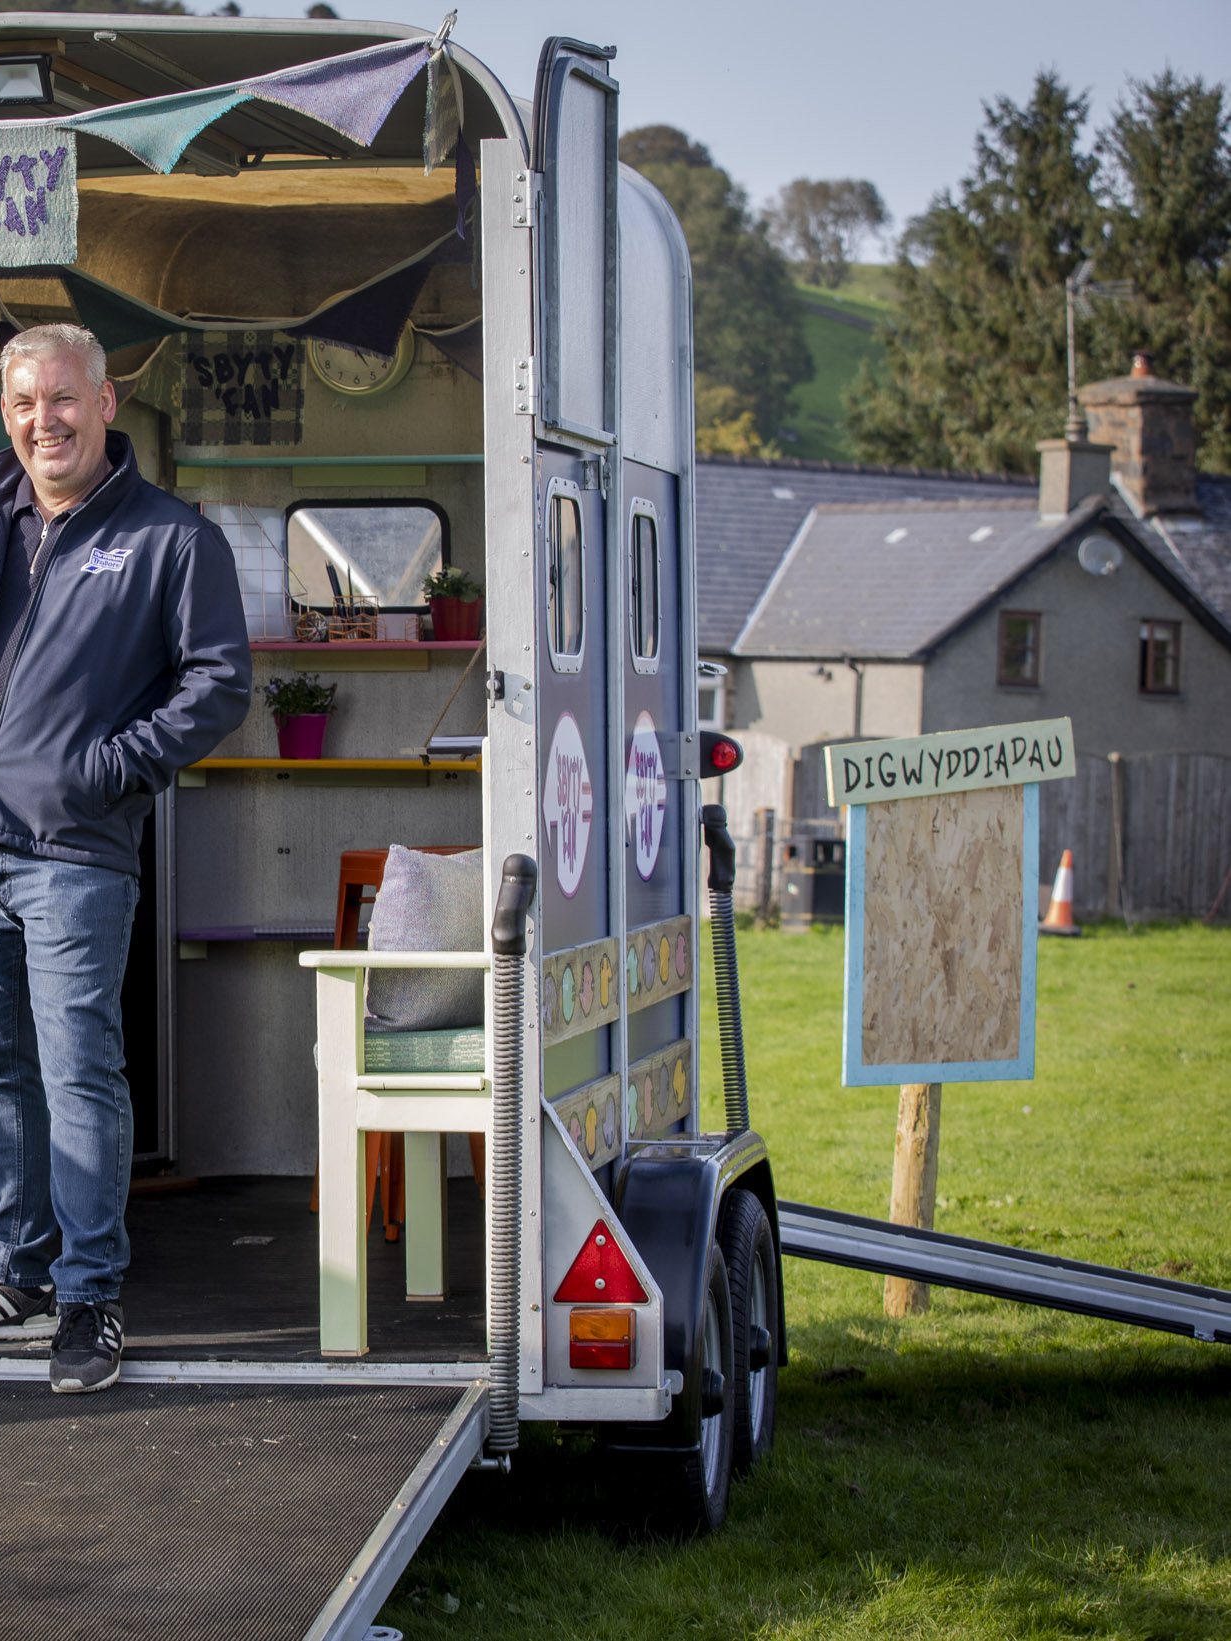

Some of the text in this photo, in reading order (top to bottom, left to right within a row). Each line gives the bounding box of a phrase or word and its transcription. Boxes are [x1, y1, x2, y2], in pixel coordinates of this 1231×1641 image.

[318, 343, 325, 352] 9
[324, 360, 331, 370] 8
[337, 371, 344, 381] 7
[353, 375, 361, 385] 6
[370, 371, 377, 381] 5
[843, 736, 1063, 793] DIGWYDDIADAU
